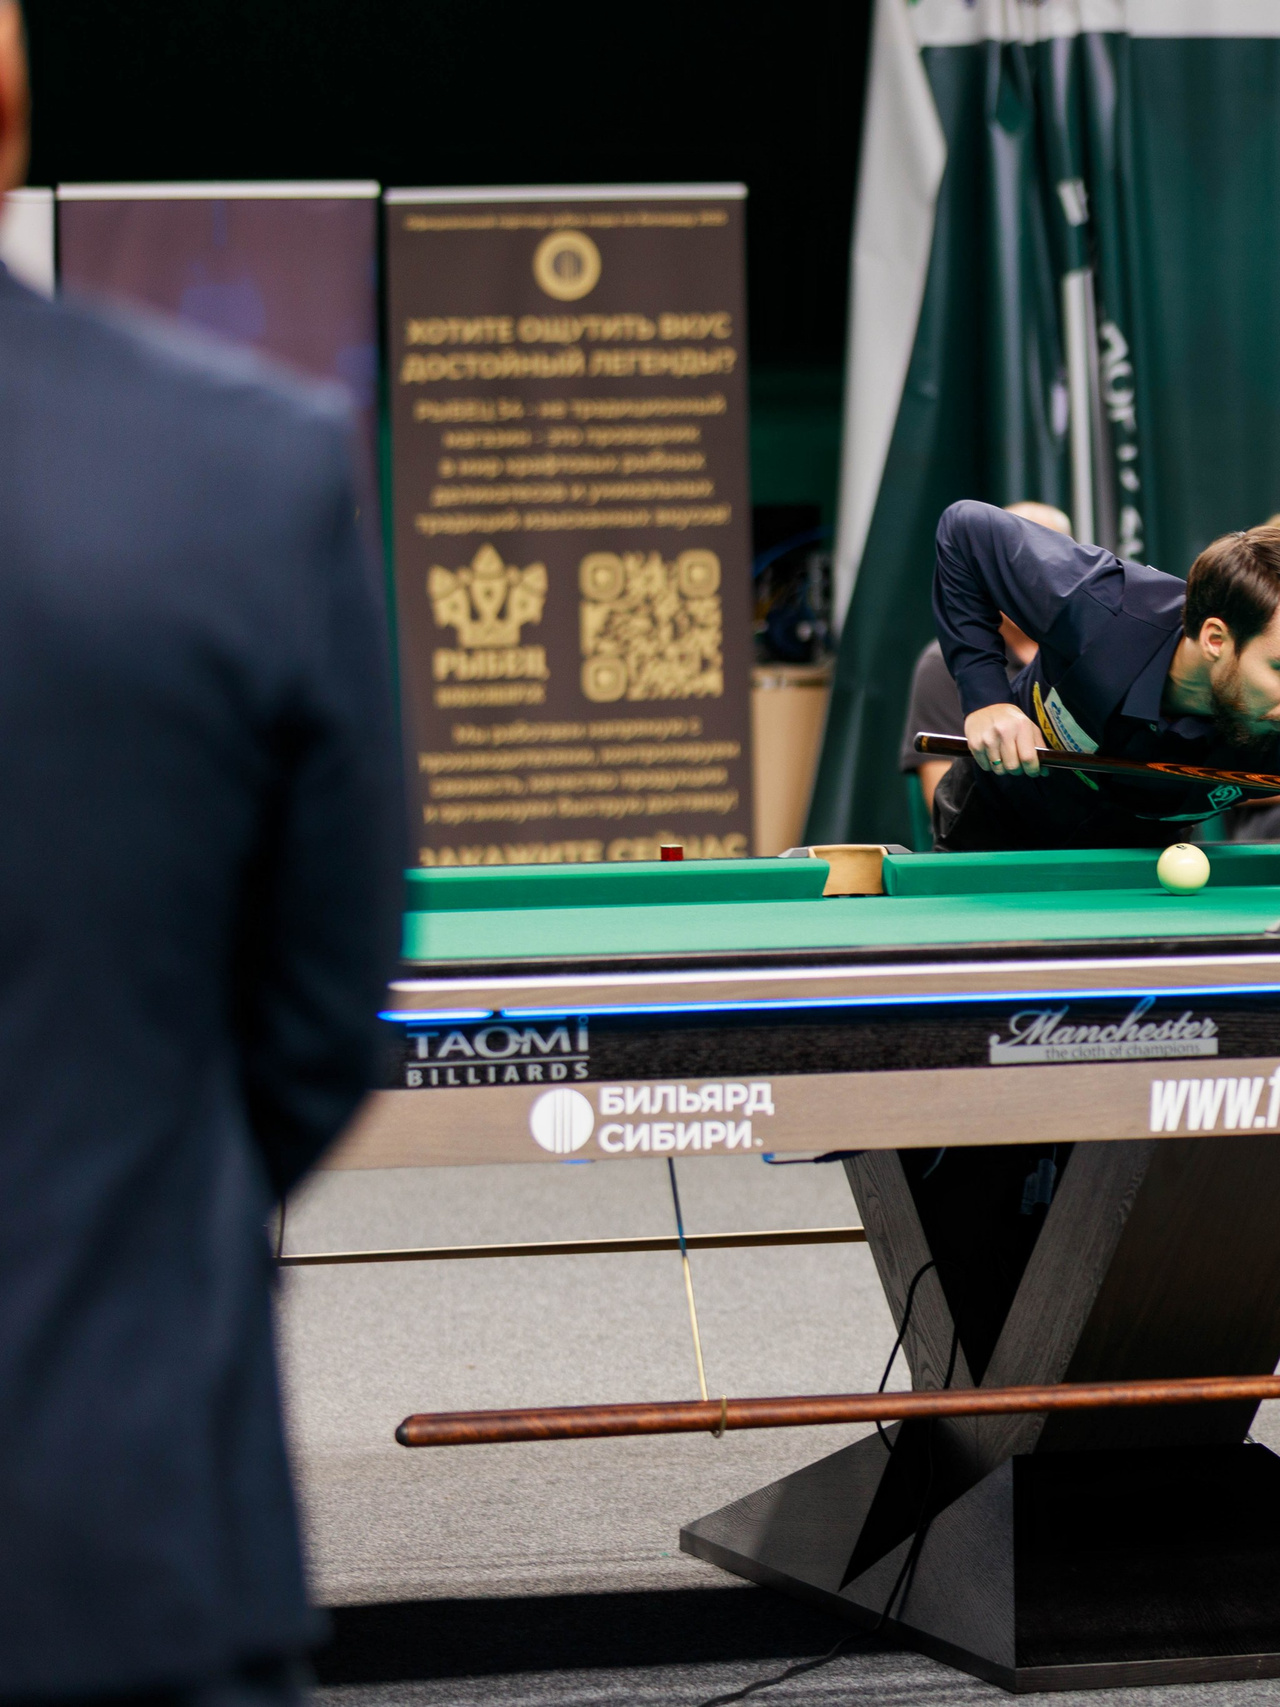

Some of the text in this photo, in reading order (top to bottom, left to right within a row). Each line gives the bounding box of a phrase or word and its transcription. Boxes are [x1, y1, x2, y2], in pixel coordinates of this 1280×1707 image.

[405, 311, 733, 346] ХОТИТЕ ОЩУТИТЬ ВКУС
[400, 345, 738, 384] ДОСТОЙНЫЙ ЛЕГЕНДЫ?
[988, 995, 1219, 1047] Manchester
[1045, 1038, 1201, 1060] the cloth of champions
[405, 1061, 590, 1088] BILLIARDS
[600, 1082, 775, 1116] БИЛЬЯРД
